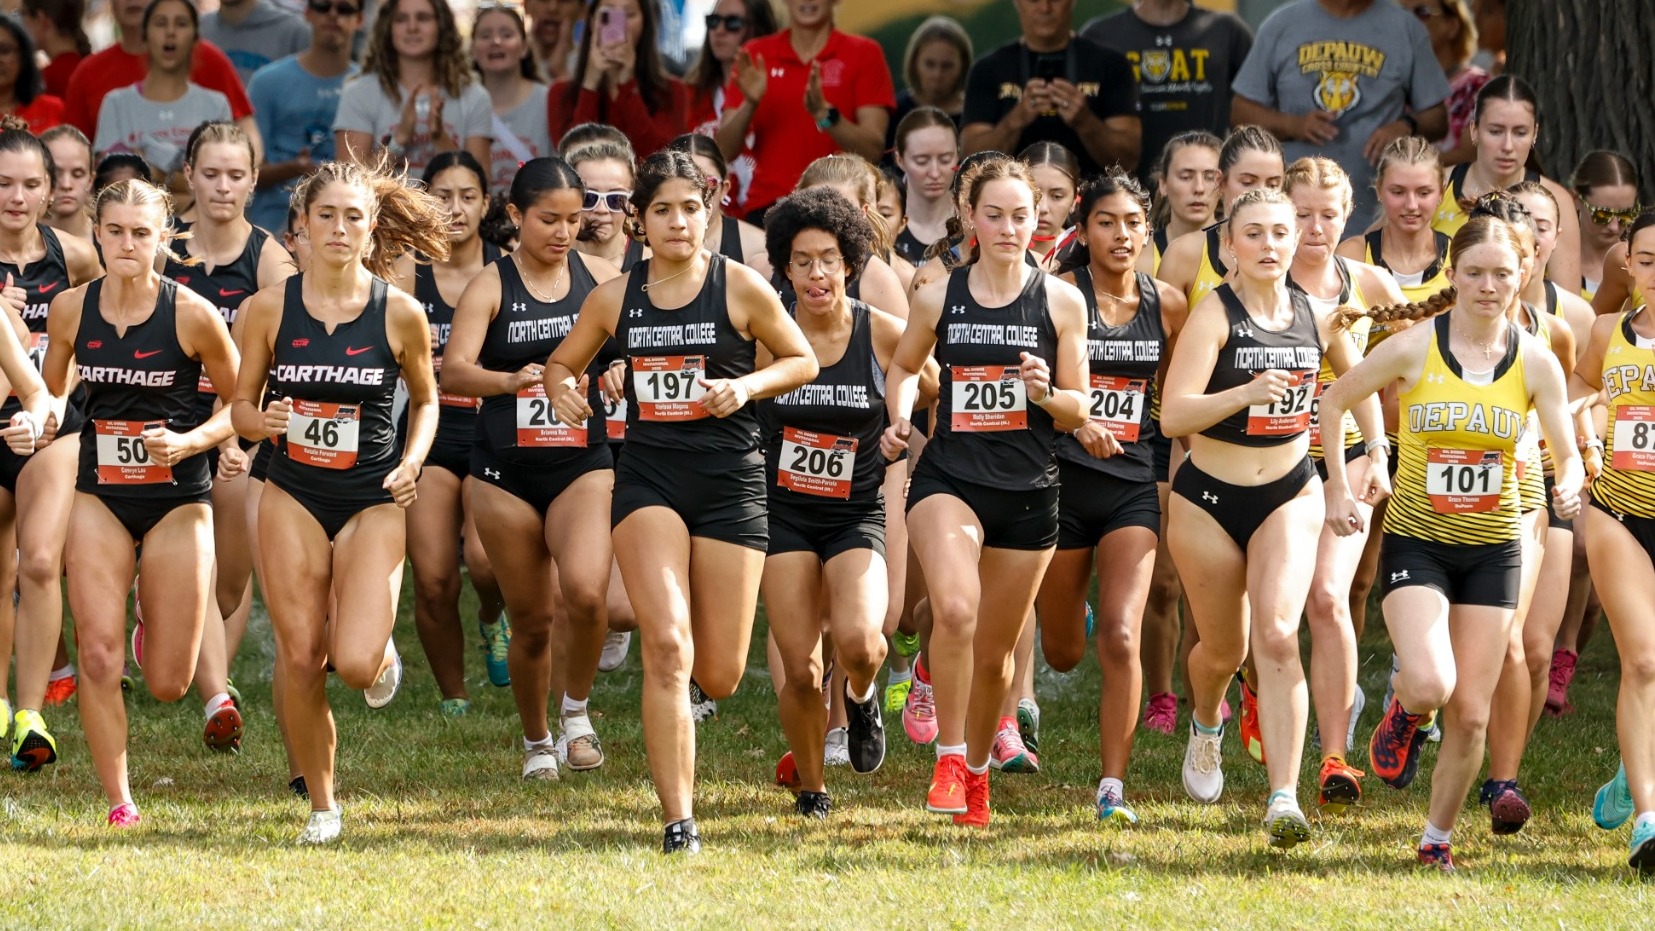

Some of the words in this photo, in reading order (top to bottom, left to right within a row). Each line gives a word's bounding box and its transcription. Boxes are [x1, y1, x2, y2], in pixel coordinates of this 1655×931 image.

[1298, 41, 1385, 68] DEPAUW
[508, 320, 537, 344] NORTH
[538, 315, 574, 340] CENTRAL
[628, 327, 652, 348] NORTH
[652, 325, 684, 347] CENTRAL
[685, 322, 716, 345] COLLEGE
[947, 323, 971, 344] NORTH
[970, 324, 1005, 345] CENTRAL
[1006, 325, 1038, 348] COLLEGE
[1087, 340, 1104, 360] RTH
[1104, 340, 1134, 361] CENTRAL
[1134, 340, 1160, 362] COLLEGE
[1234, 347, 1263, 370] NORTH
[1264, 346, 1297, 369] CENTRAL
[278, 365, 384, 386] CARTHAGE
[647, 372, 696, 400] 197
[1602, 364, 1655, 402] EPA
[800, 384, 834, 406] CENTRAL
[836, 384, 870, 408] COLLEGE
[964, 383, 1016, 410] 205
[1090, 390, 1134, 420] 204
[529, 399, 560, 426] 20
[305, 419, 338, 448] 46
[1632, 422, 1655, 450] 8
[117, 438, 148, 464] 50
[790, 446, 844, 478] 206
[1441, 466, 1490, 493] 101
